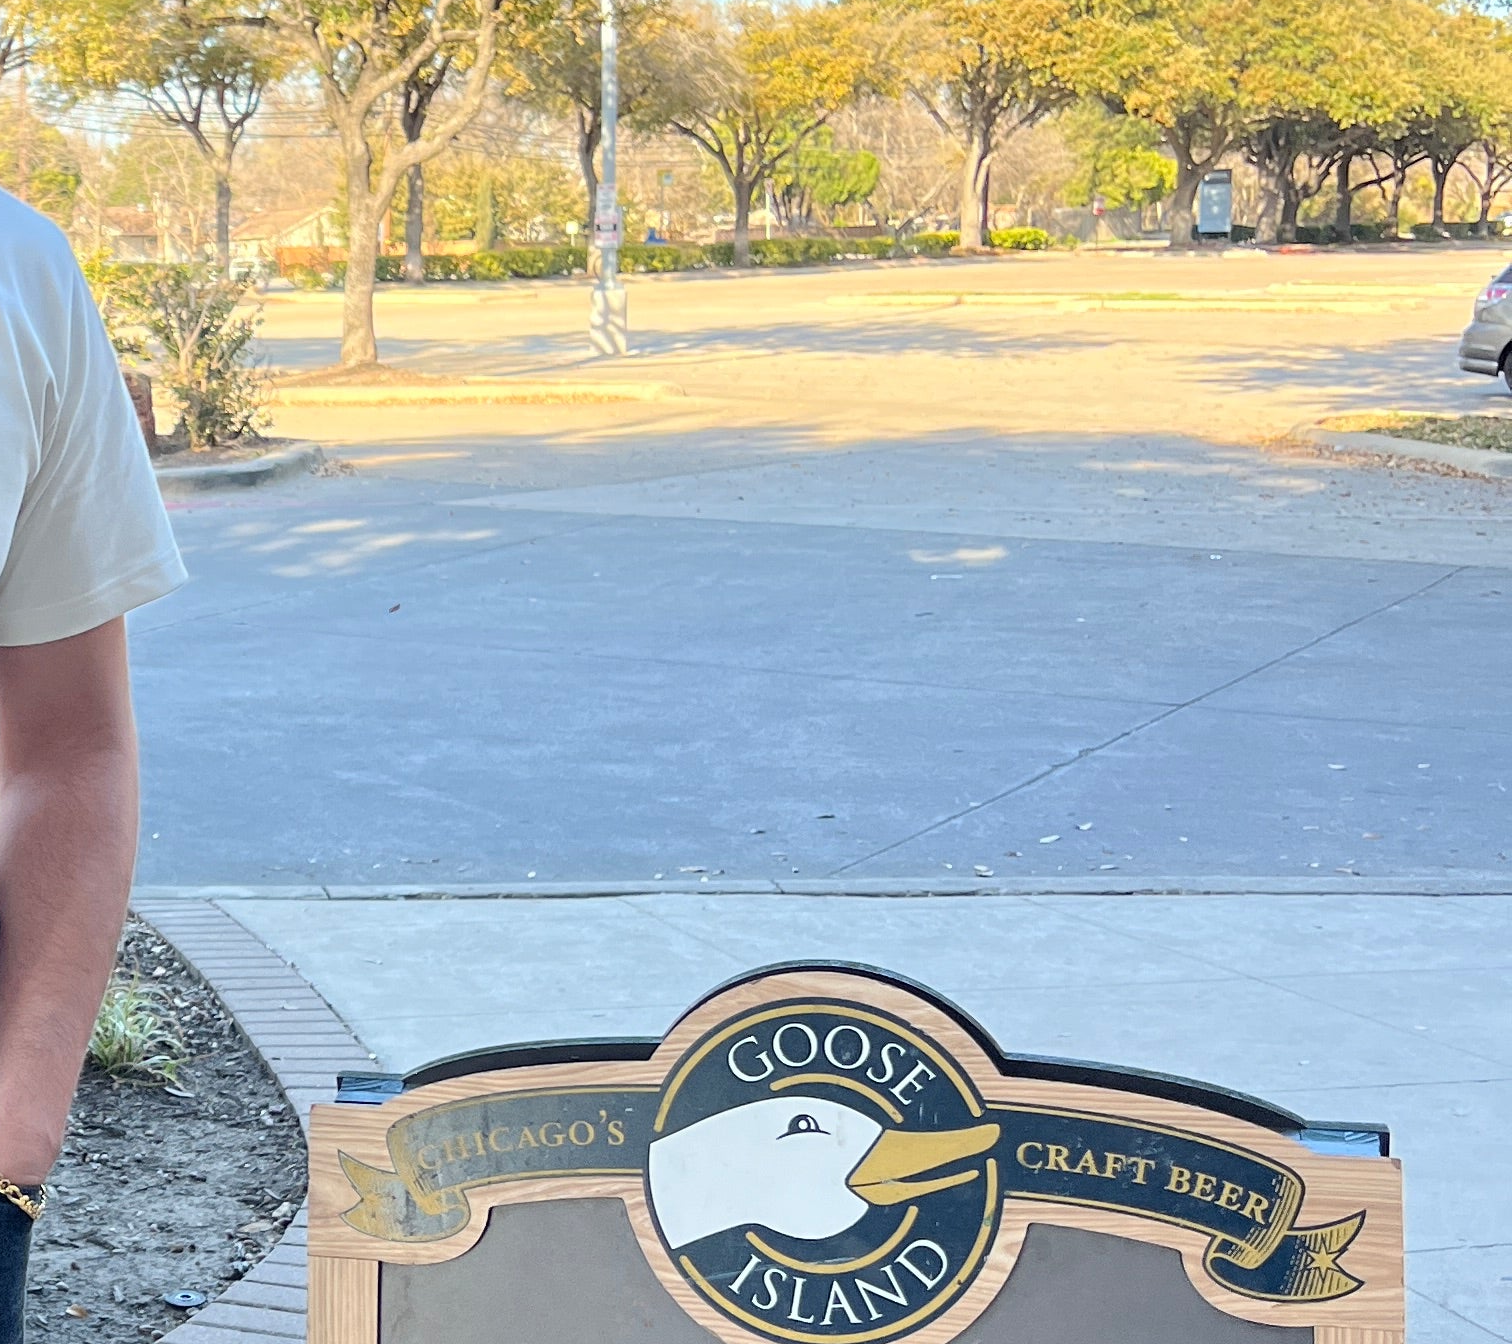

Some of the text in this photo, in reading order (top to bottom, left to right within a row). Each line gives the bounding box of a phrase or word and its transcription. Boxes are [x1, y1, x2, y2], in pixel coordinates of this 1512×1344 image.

[727, 1022, 937, 1106] GOOSE
[418, 1109, 625, 1170] CHICAGO'S
[1016, 1141, 1270, 1225] CRAFT BEER
[727, 1239, 948, 1326] ISLAND
